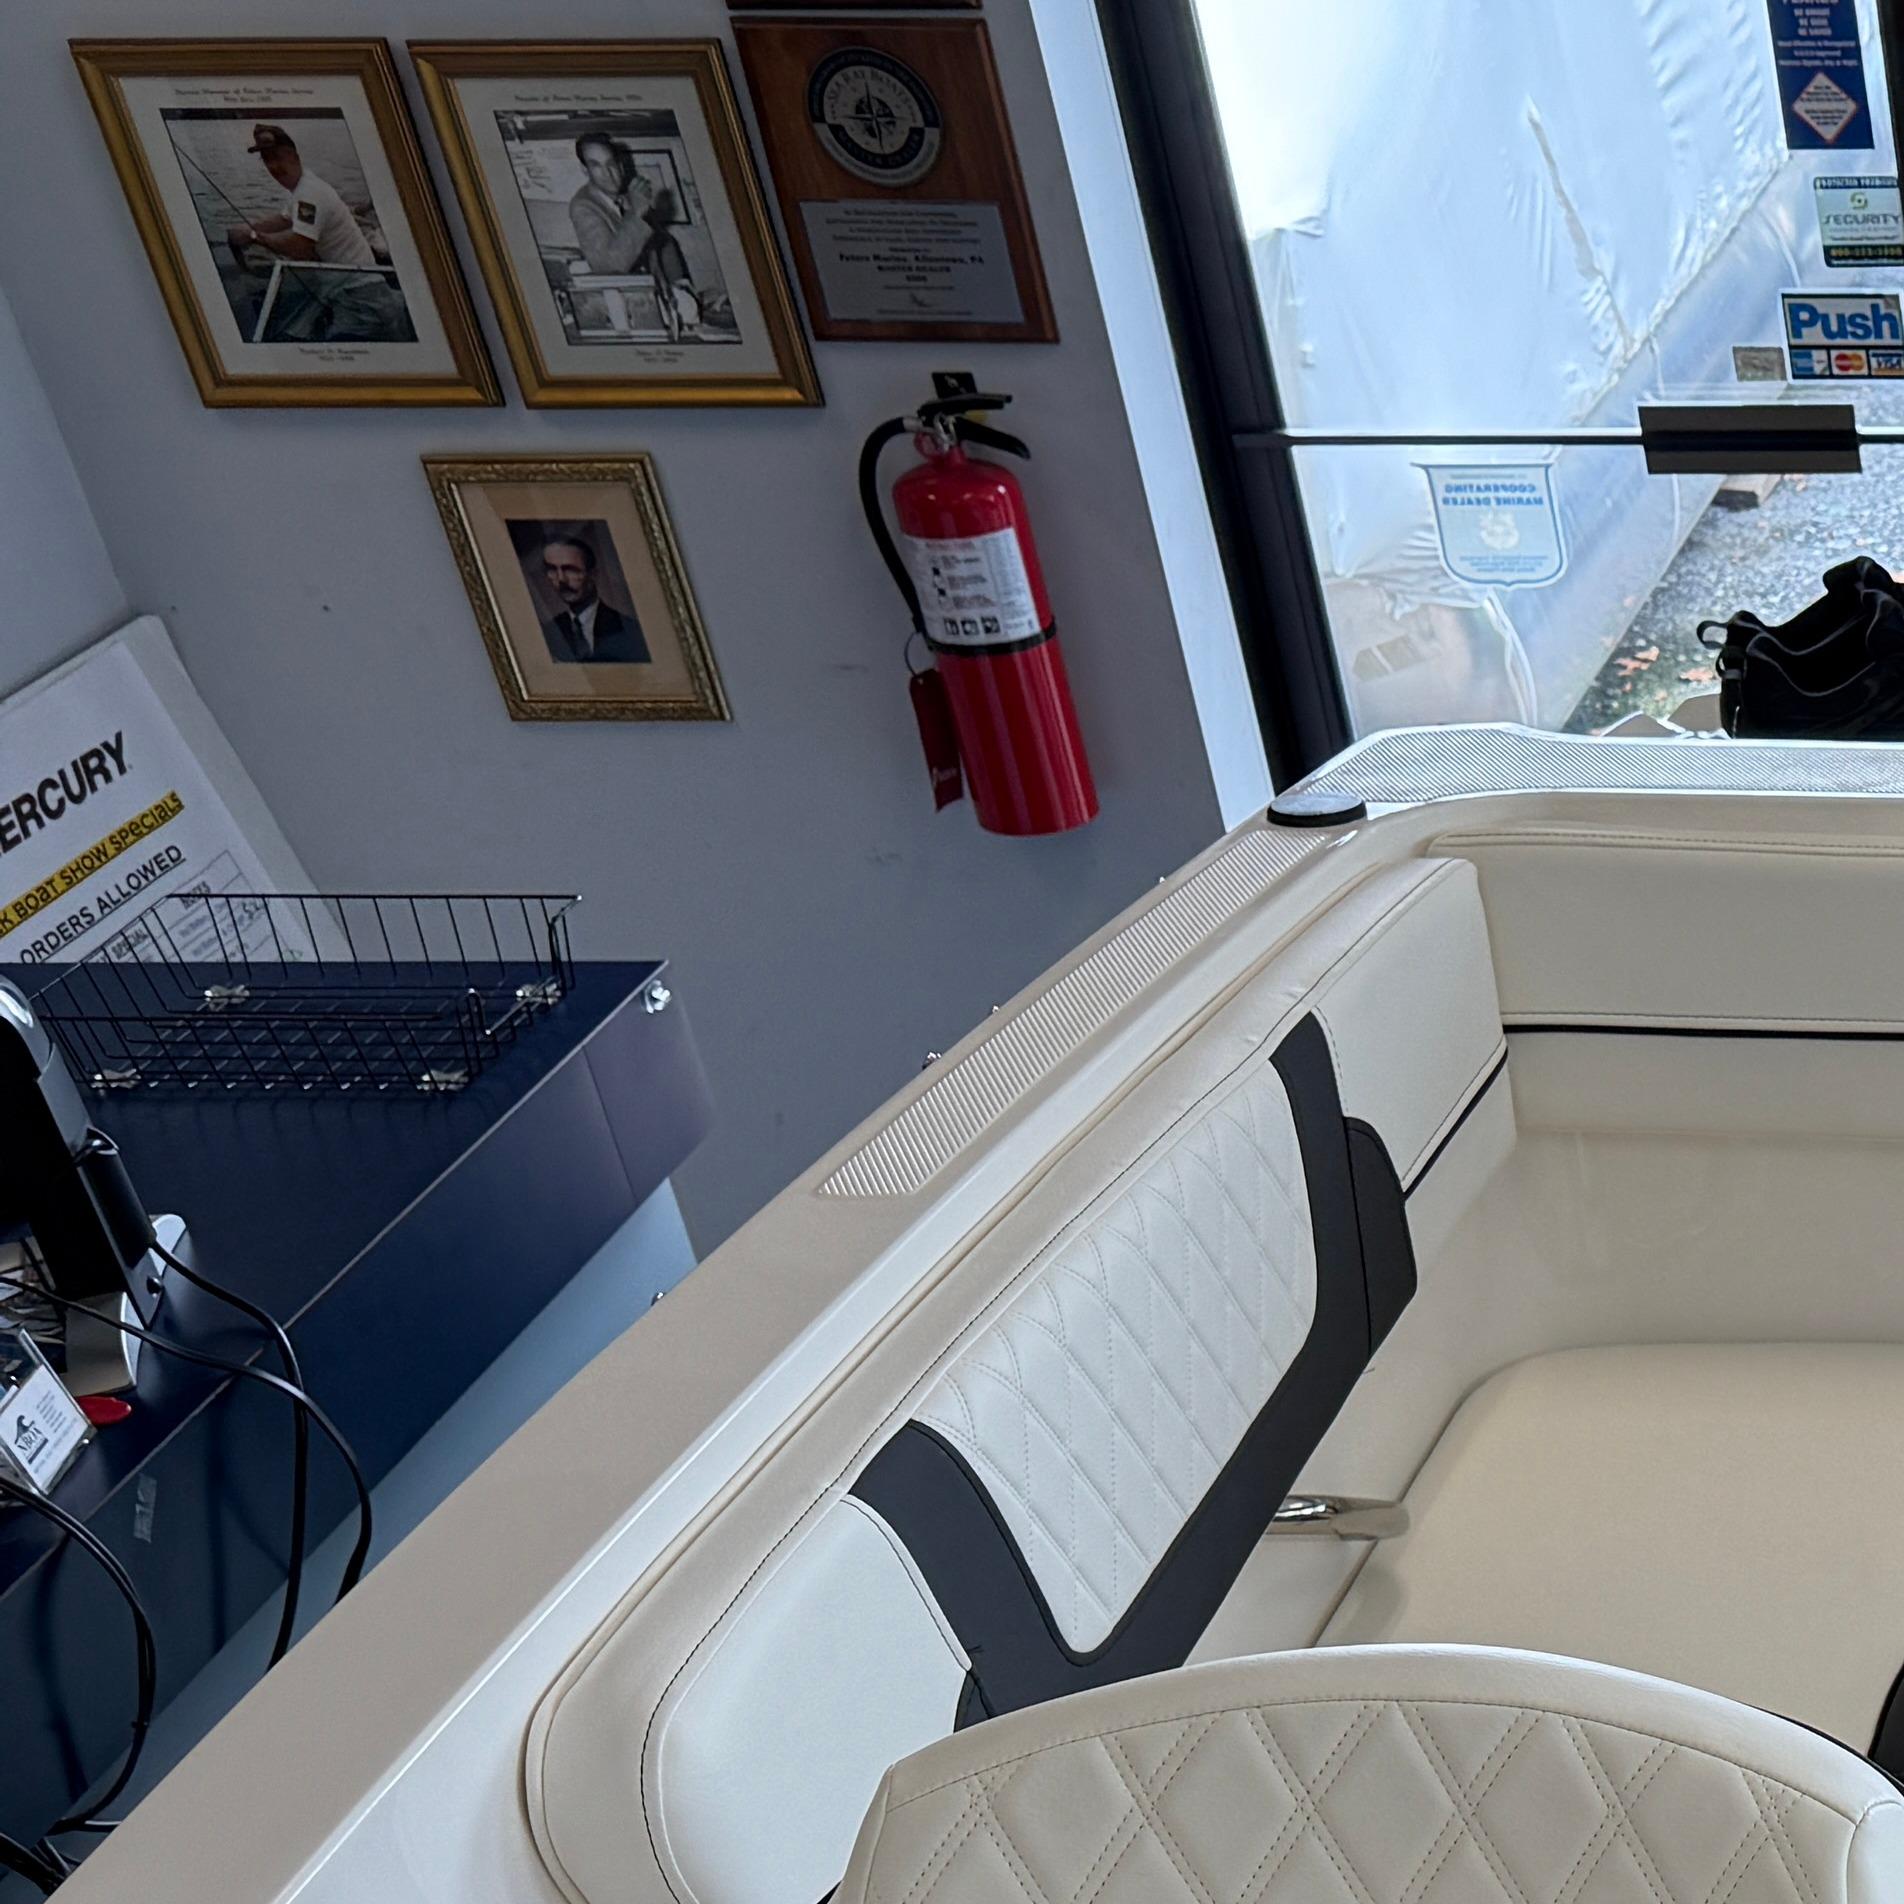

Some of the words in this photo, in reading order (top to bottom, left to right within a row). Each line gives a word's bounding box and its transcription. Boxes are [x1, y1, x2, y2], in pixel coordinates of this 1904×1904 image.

[1822, 214, 1900, 225] SECURITY
[1788, 302, 1900, 340] Push
[0, 731, 128, 857] ERCURY
[60, 840, 112, 887] SHOW
[20, 905, 96, 964] ORDERS
[97, 845, 183, 915] ALLOWED
